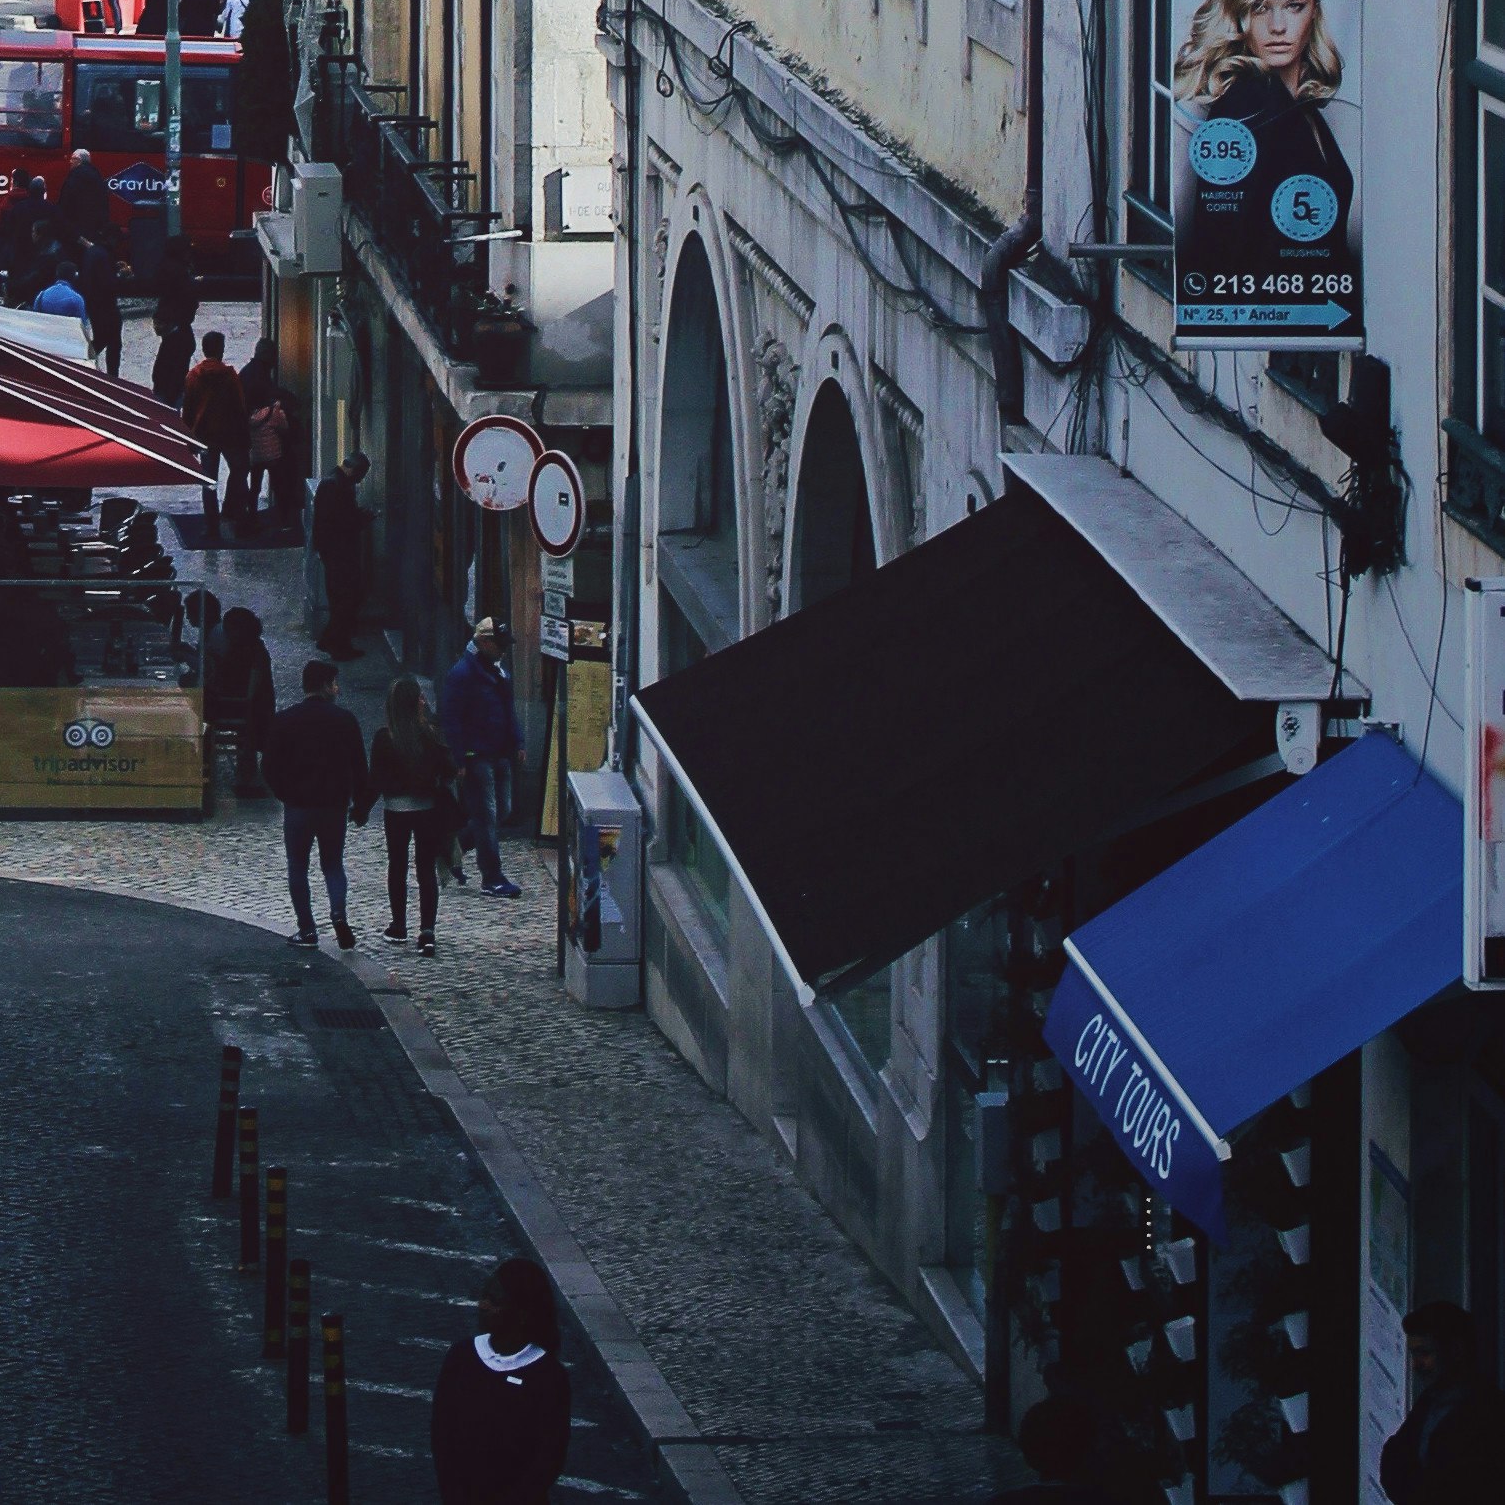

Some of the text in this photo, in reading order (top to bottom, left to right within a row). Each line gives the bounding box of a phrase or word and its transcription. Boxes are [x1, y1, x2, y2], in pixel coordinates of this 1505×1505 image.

[1200, 190, 1245, 201] HAIRCUT
[1206, 203, 1239, 212] CORTE
[1279, 248, 1330, 258] BRUSHING
[1213, 274, 1353, 295] 213 468 268
[1248, 308, 1290, 320] Andar
[33, 754, 139, 773] tripadvisor
[1074, 1013, 1181, 1180] CITY TOURS
